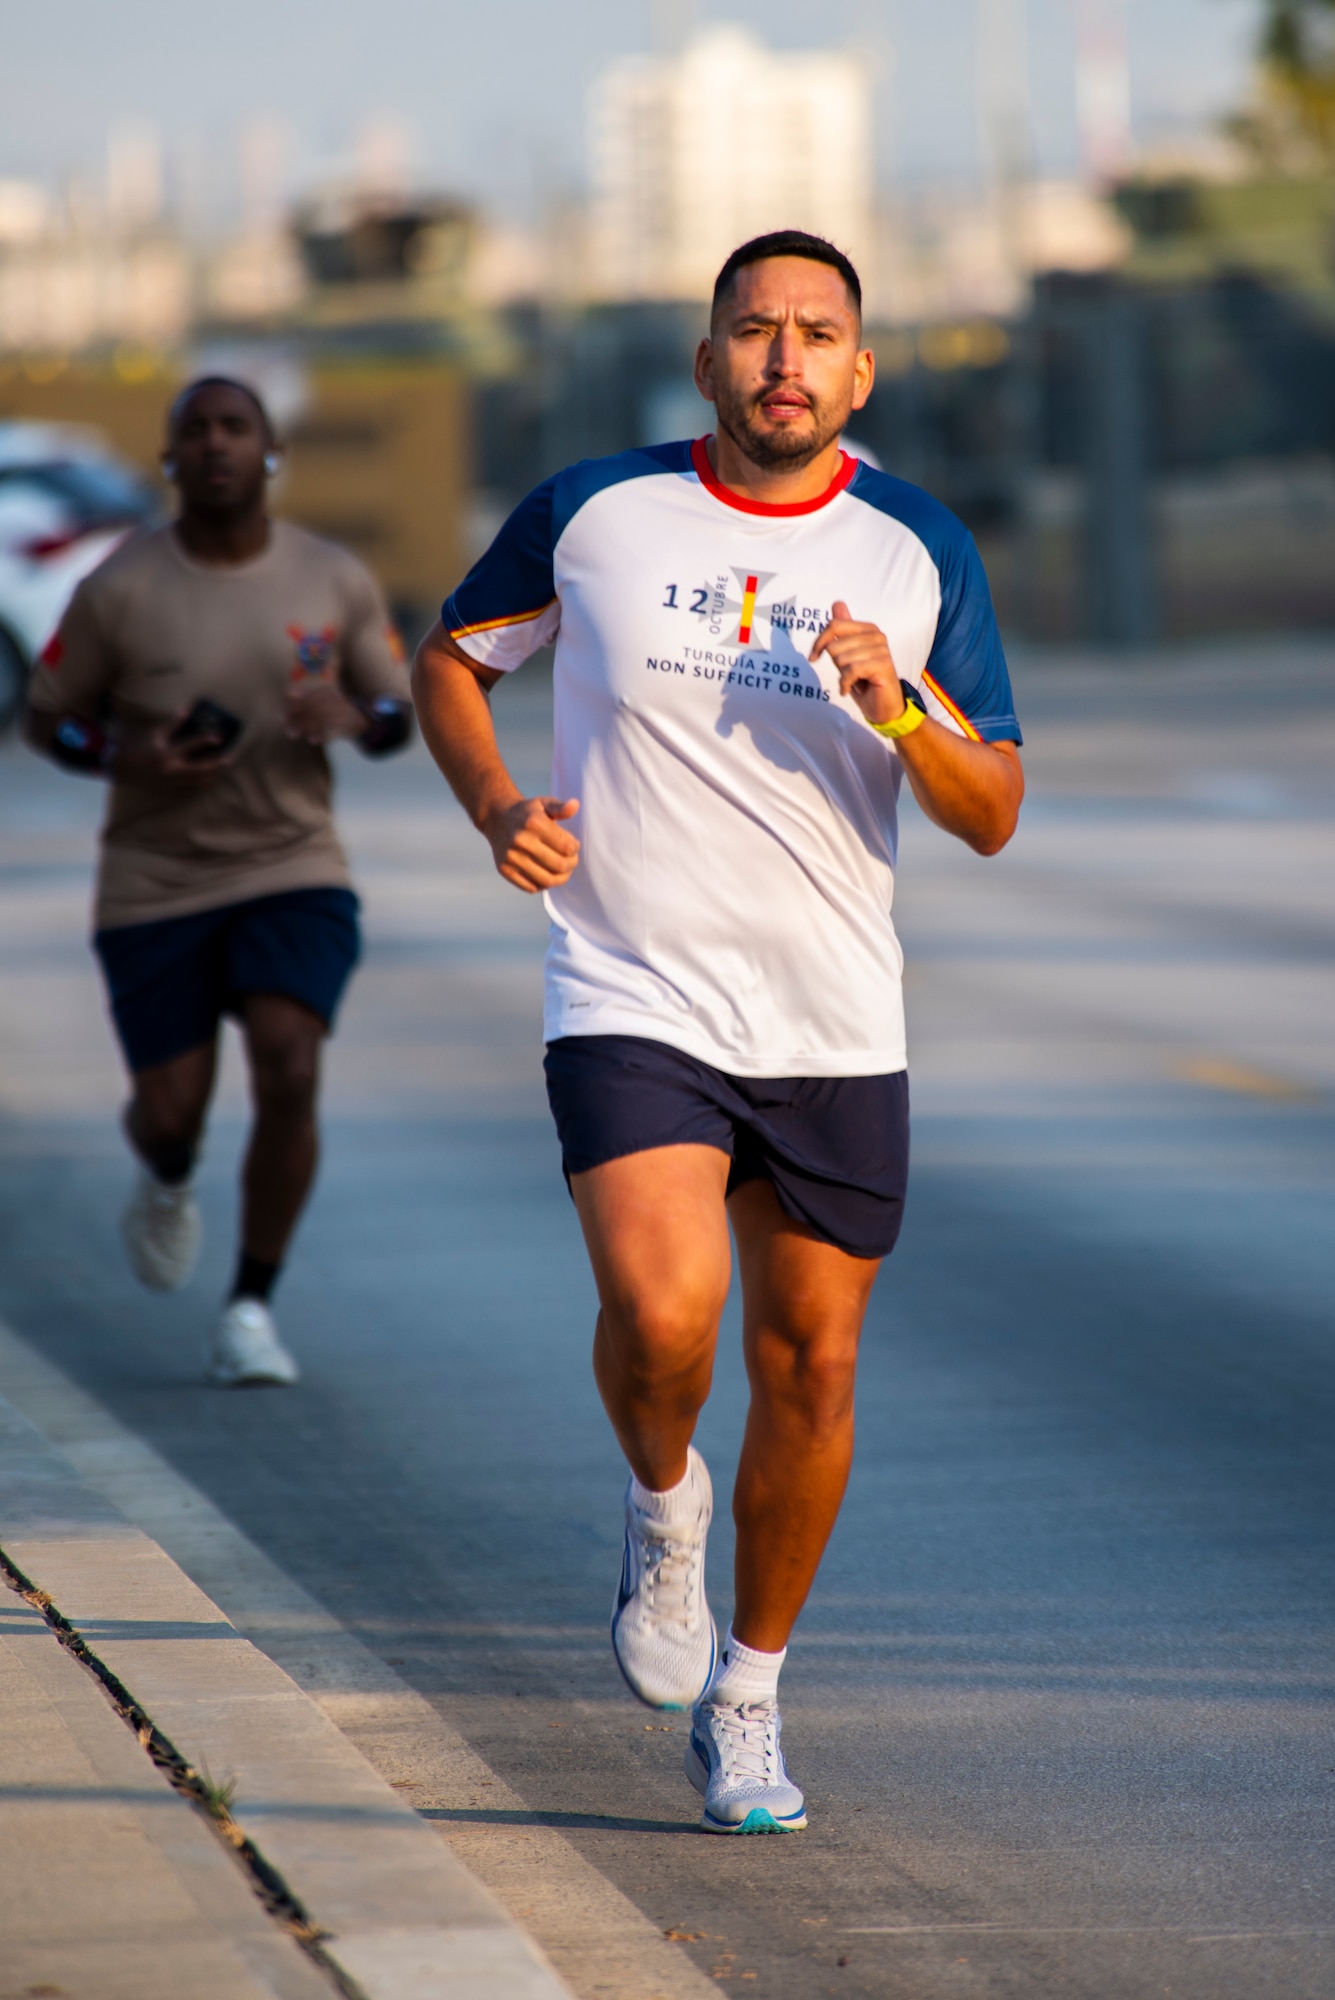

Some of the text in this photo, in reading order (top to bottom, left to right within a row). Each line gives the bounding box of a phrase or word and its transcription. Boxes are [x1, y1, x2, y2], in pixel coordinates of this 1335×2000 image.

[662, 584, 708, 614] 12
[709, 575, 728, 635] OCTUBRE
[772, 602, 796, 616] DÍA
[802, 607, 820, 619] DE
[771, 615, 828, 634] HISPAN
[683, 647, 800, 678] TURQUÍA 2025
[647, 658, 831, 702] NON SUFFICIT ORBIS
